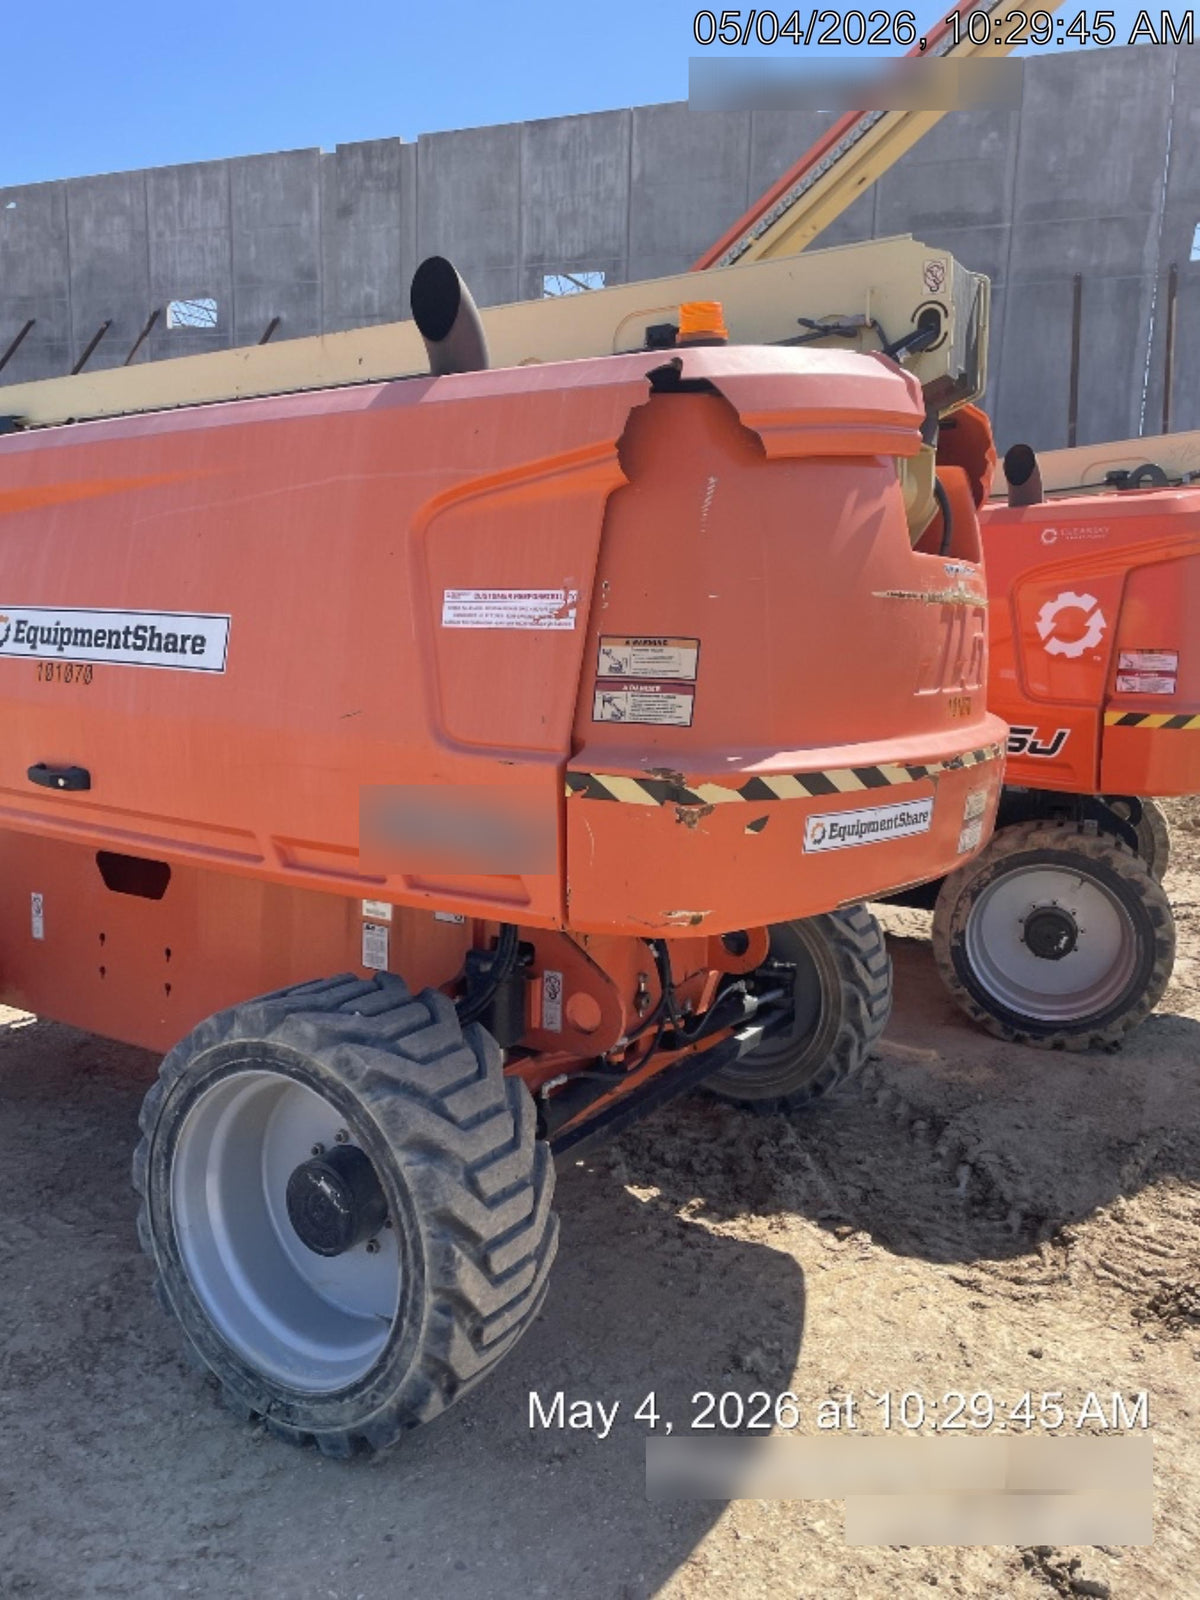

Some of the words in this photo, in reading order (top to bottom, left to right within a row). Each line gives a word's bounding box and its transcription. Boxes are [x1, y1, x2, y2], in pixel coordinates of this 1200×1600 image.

[13, 618, 207, 656] EquipmentShare
[37, 662, 94, 685] 101070
[828, 811, 929, 842] EquipmentShare
